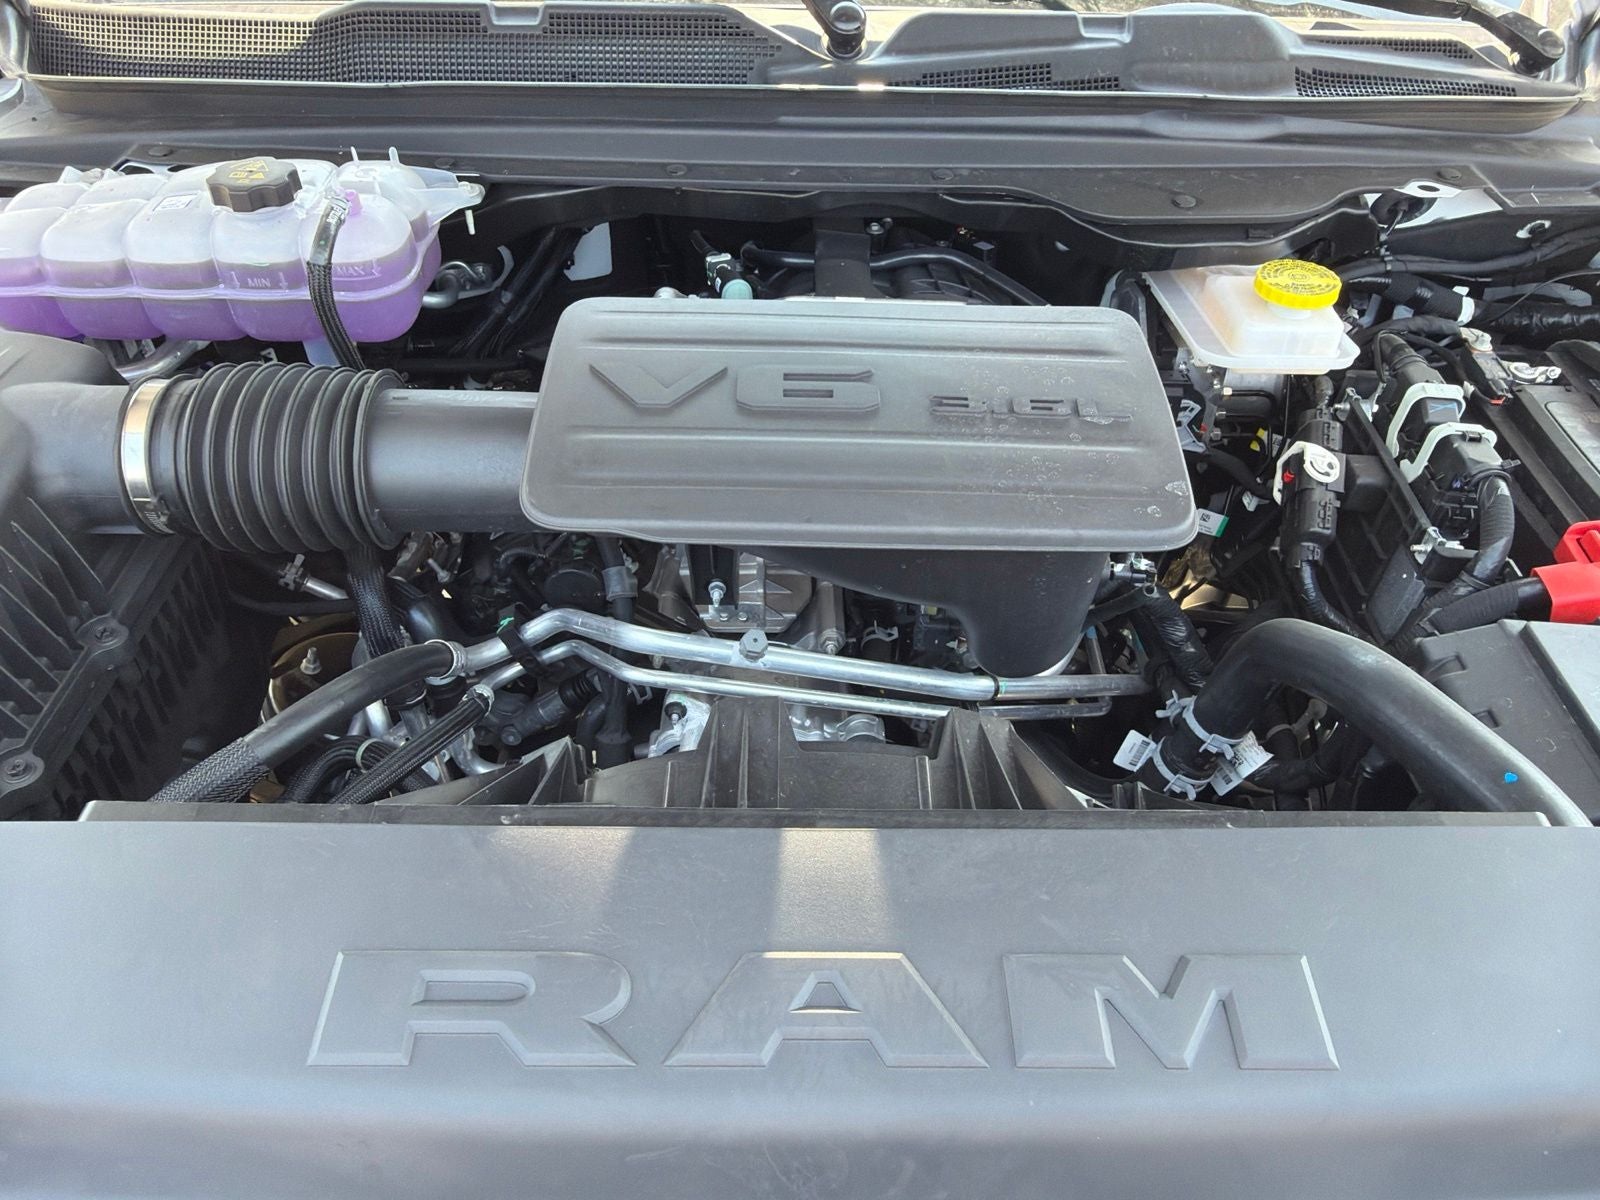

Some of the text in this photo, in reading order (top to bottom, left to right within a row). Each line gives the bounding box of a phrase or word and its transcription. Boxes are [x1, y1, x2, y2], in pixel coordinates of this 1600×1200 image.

[247, 277, 271, 288] MIN
[335, 265, 366, 276] MAX
[588, 363, 881, 411] V6
[928, 392, 1134, 423] 3.6L
[306, 948, 1341, 1070] RAM
